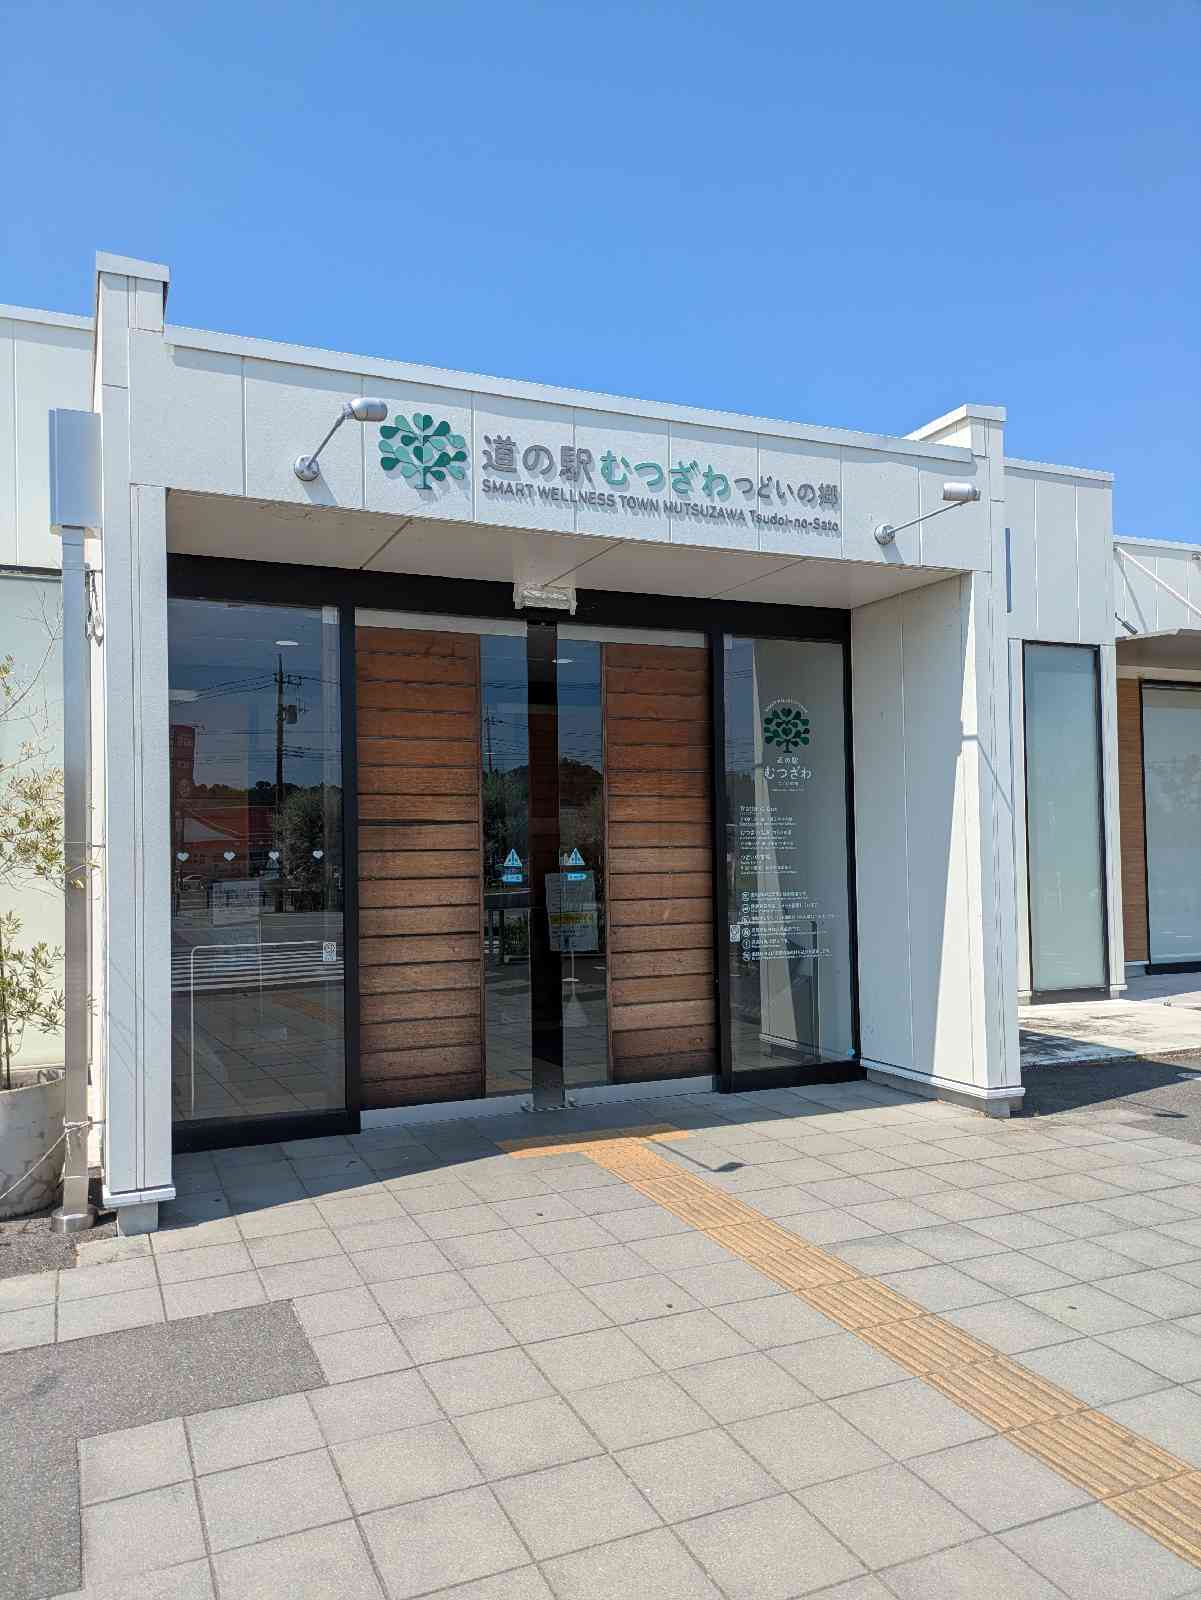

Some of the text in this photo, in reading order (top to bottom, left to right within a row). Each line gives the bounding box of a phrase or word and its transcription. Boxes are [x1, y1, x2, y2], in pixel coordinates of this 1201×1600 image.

[482, 479, 839, 532] SMART WELLNESS TOWN MUTSUZAWA Tsudoi-no-Sato
[764, 766, 812, 780] むつざわ
